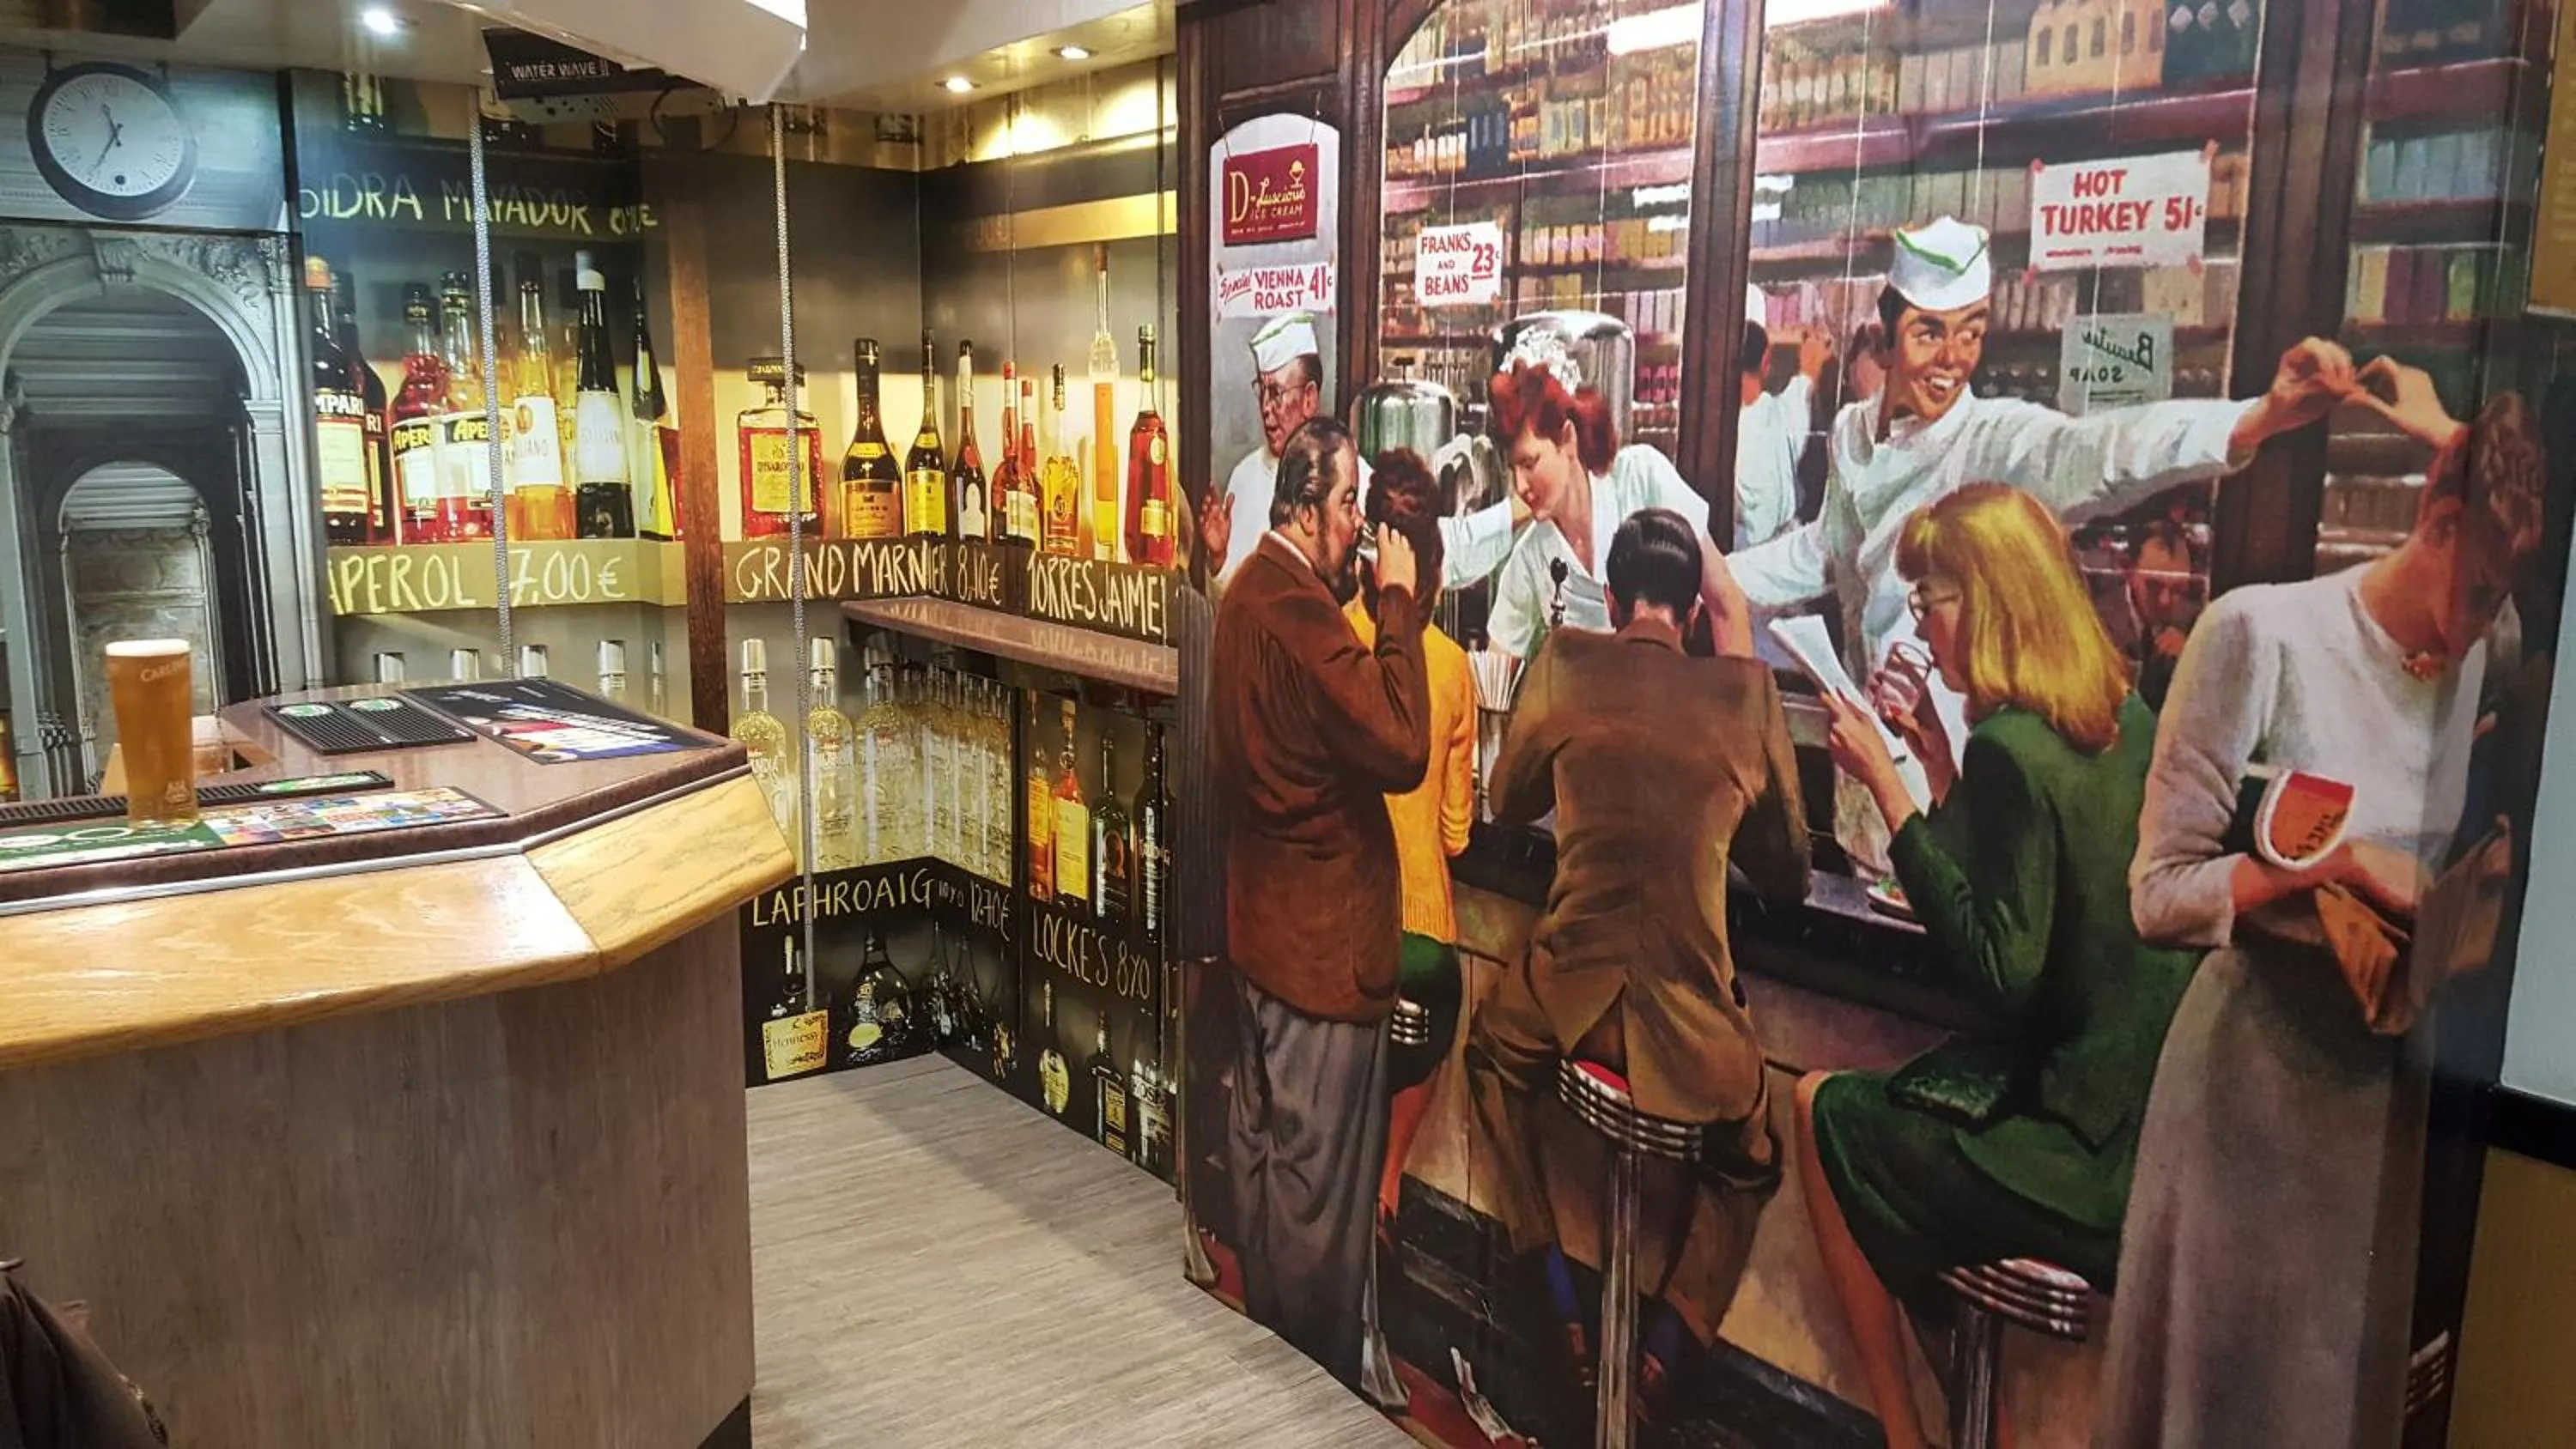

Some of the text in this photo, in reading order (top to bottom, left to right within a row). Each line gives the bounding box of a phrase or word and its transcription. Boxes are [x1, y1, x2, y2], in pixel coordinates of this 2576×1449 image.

[511, 63, 556, 78] WATER
[558, 61, 597, 77] WAVE
[2074, 169, 2129, 198] HOT
[1249, 203, 1303, 221] ICE CREAM
[2040, 199, 2154, 236] TURKEY
[1420, 232, 1472, 255] FRANKS
[1437, 259, 1455, 270] AND
[1255, 268, 1304, 290] VIENNA
[1425, 274, 1469, 296] BEANS
[1255, 288, 1304, 310] ROAST
[736, 544, 846, 600] GRAND
[853, 540, 949, 595] MARNIER
[1027, 550, 1097, 621] TORRES
[752, 867, 934, 927] LAPHROAIG
[1033, 904, 1109, 987] LOCKE'S
